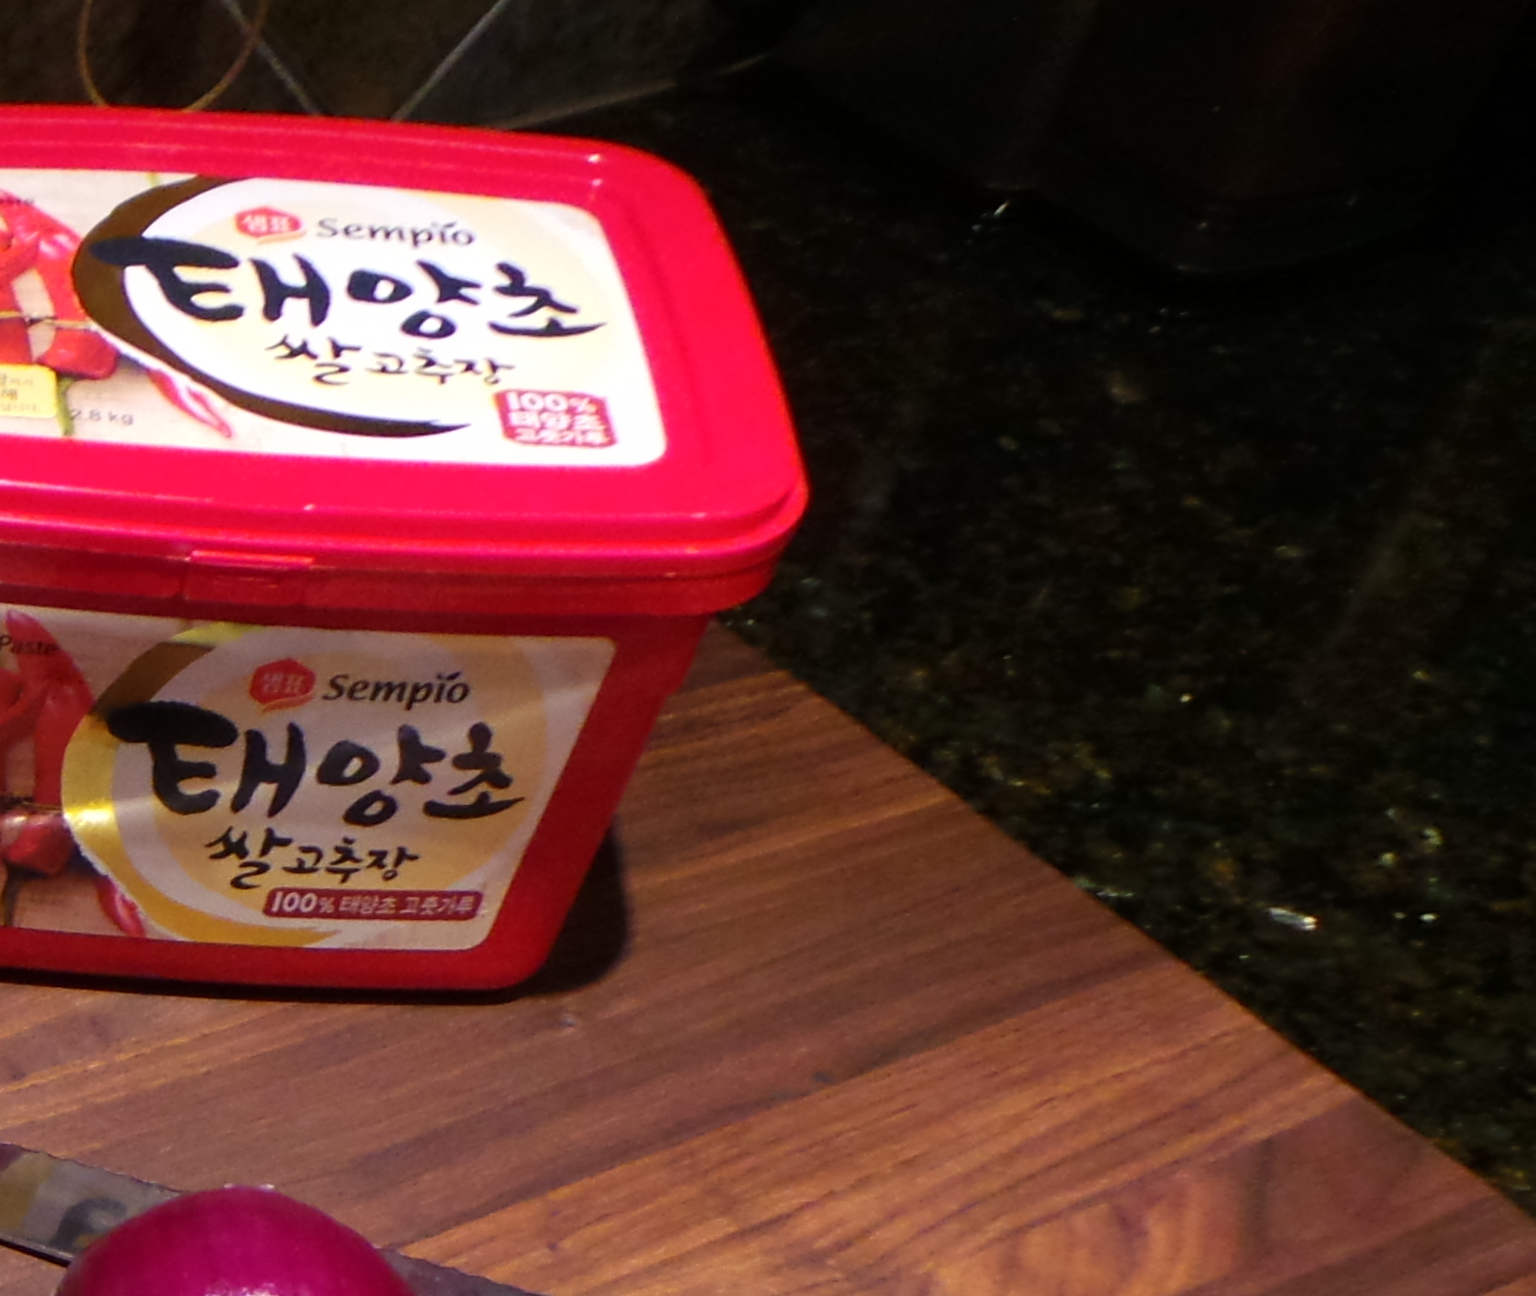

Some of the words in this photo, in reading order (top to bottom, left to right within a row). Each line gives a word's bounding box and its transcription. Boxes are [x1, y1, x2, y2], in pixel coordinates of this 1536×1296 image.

[316, 217, 475, 248] Sempio
[87, 235, 609, 340] 태양초
[506, 391, 598, 413] 100%
[108, 411, 134, 426] kg
[322, 671, 471, 711] Sempio
[106, 700, 526, 828] 태양초
[271, 890, 335, 914] 100%
[338, 895, 397, 915] 태양초
